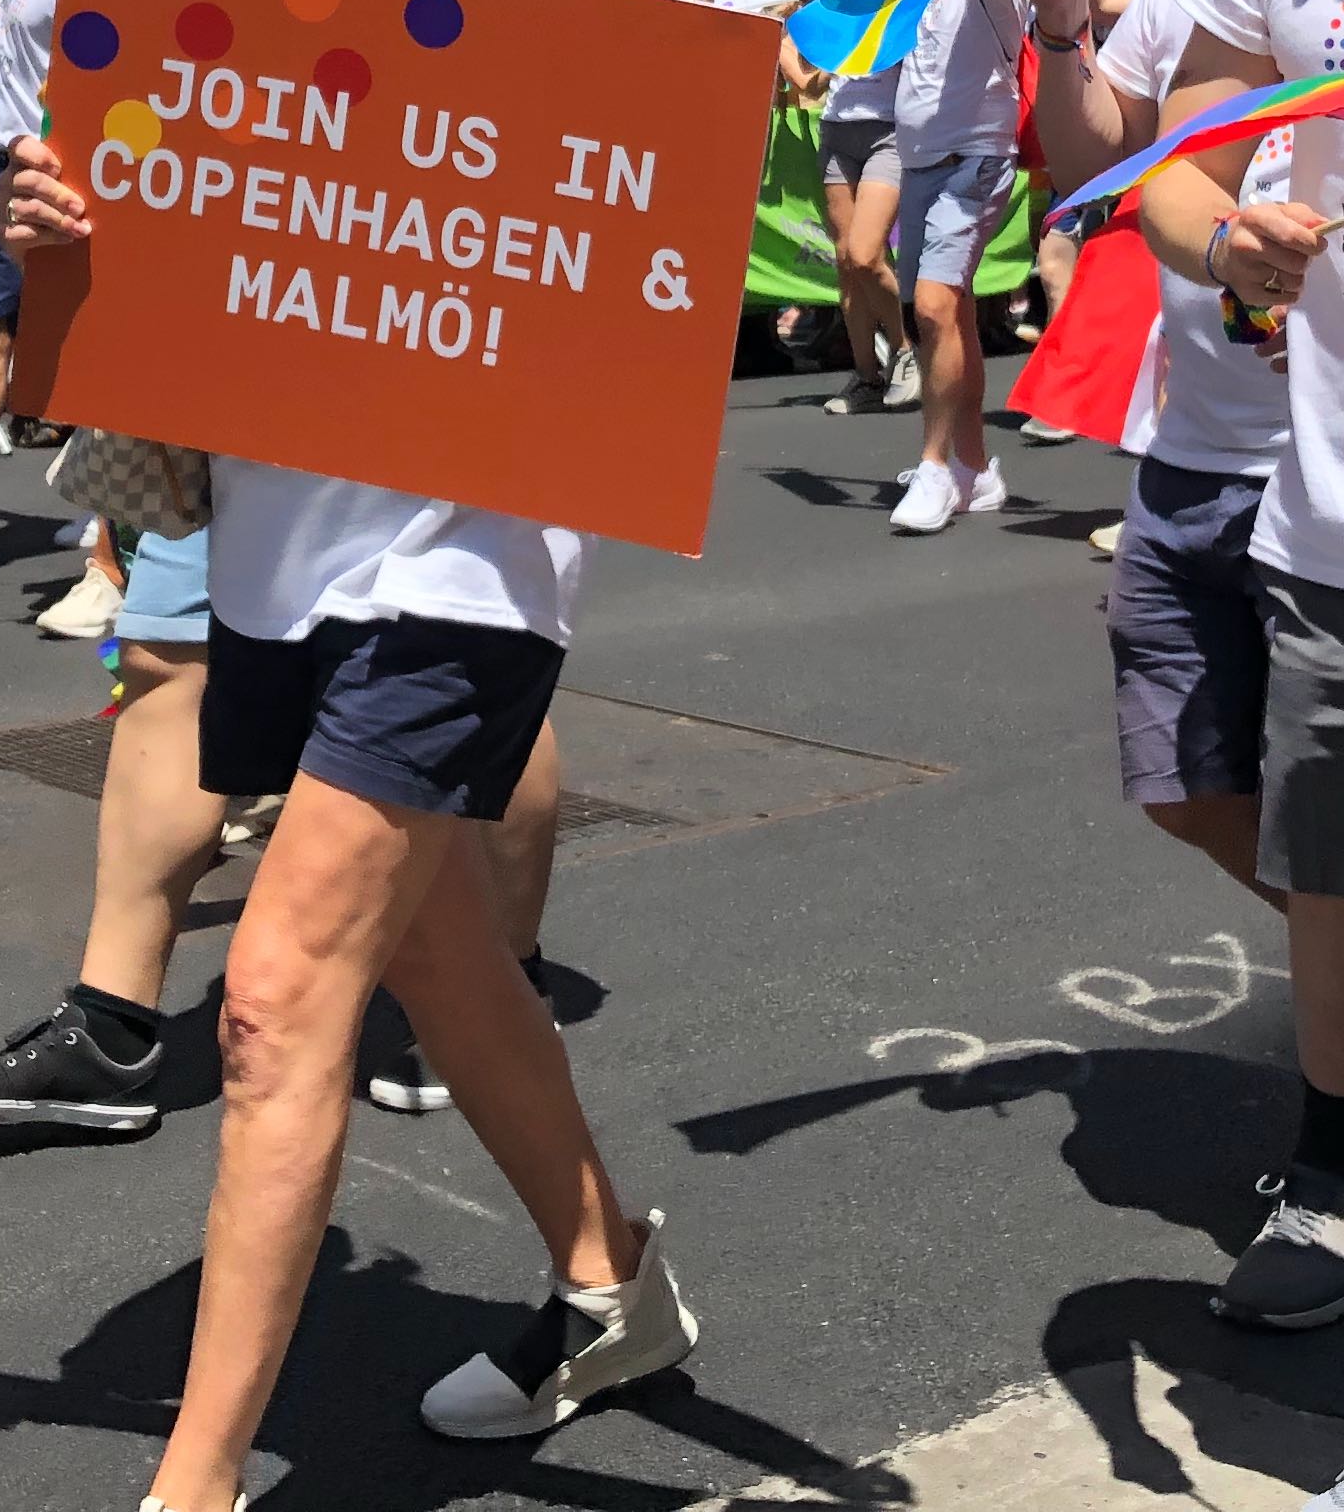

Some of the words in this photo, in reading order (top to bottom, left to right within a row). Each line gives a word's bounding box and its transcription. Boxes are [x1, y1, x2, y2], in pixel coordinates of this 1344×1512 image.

[147, 57, 350, 153] JOIN
[400, 103, 499, 180] US
[554, 134, 656, 213] IN
[89, 139, 591, 293] COPENHAGEN
[641, 248, 694, 312] &
[226, 253, 504, 367] MALMÖ!
